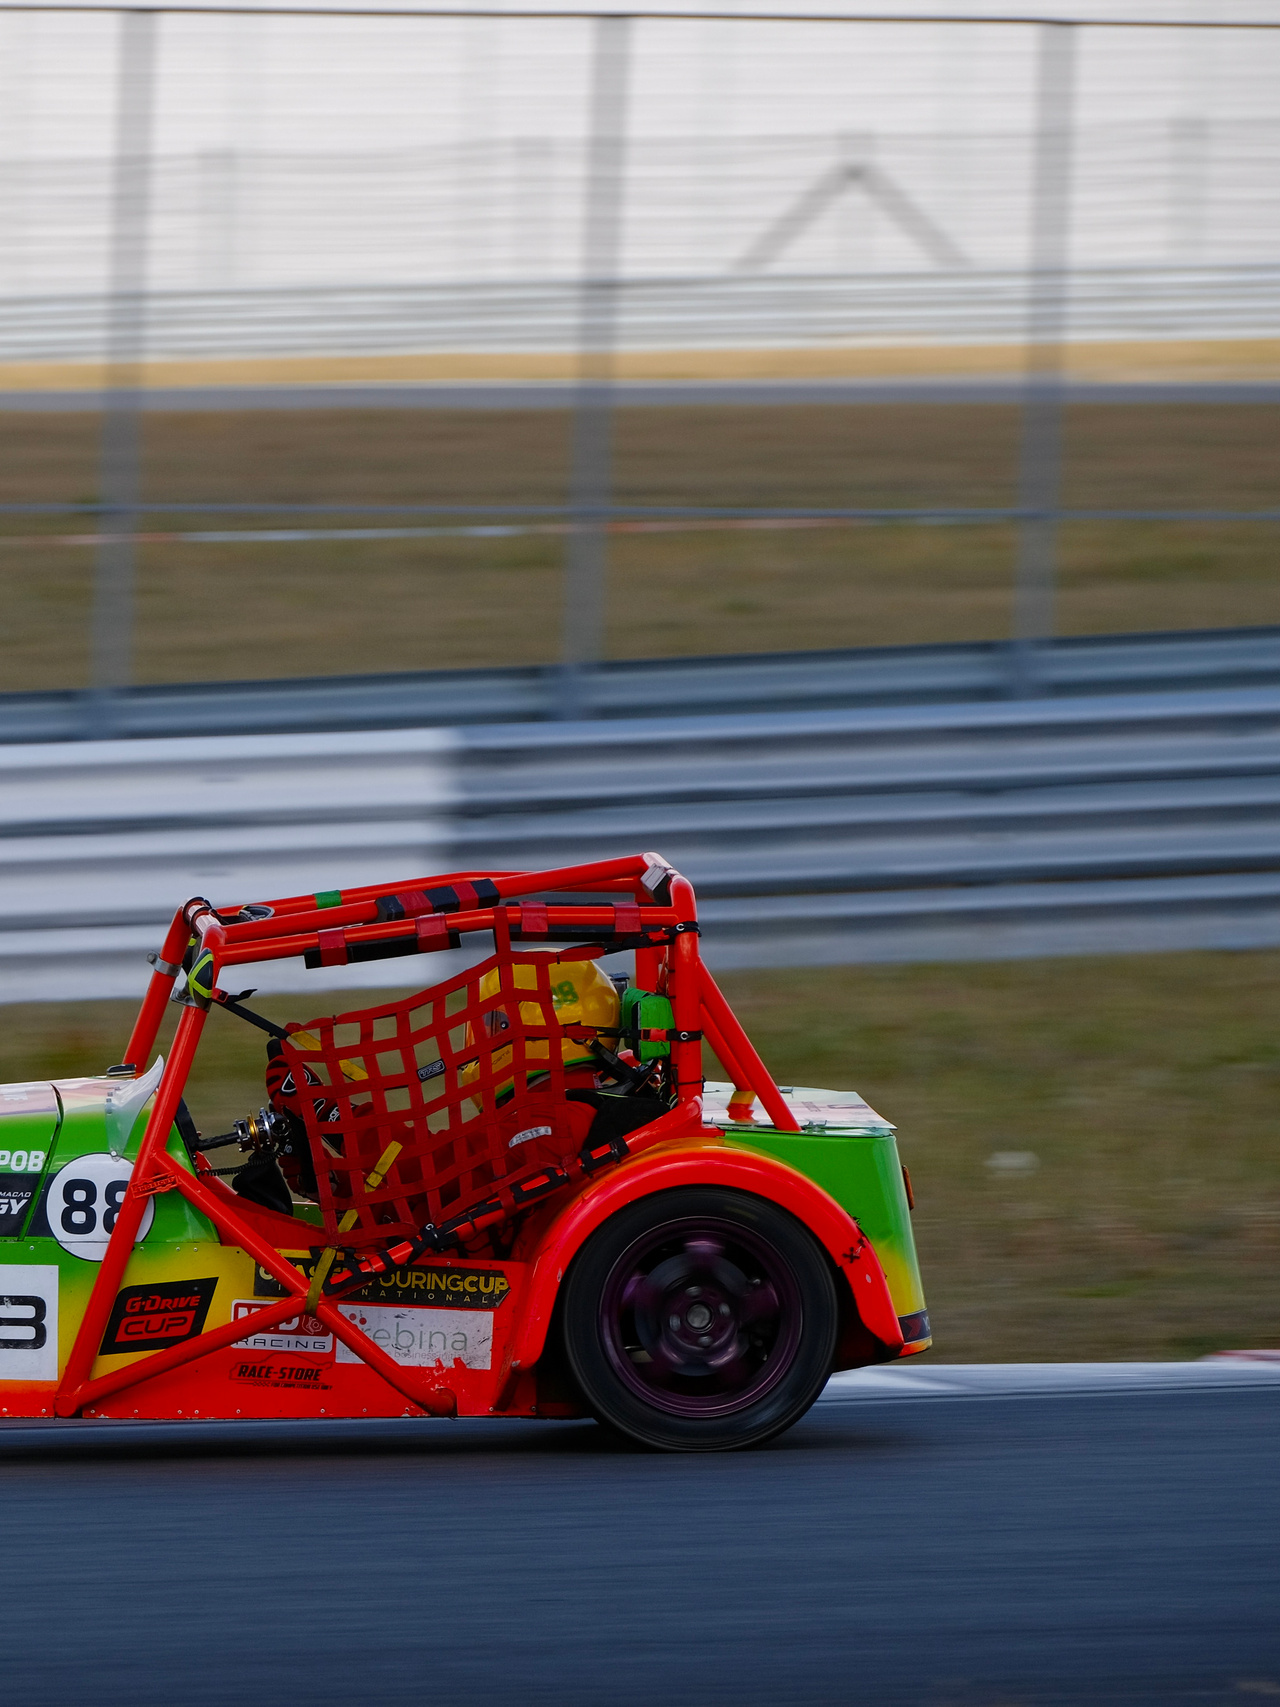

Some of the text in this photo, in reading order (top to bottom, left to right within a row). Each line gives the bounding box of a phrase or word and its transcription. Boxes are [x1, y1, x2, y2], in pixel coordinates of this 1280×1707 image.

[124, 1316, 188, 1335] CUP
[235, 1338, 326, 1350] RACING
[237, 1365, 323, 1381] RACE-STORE
